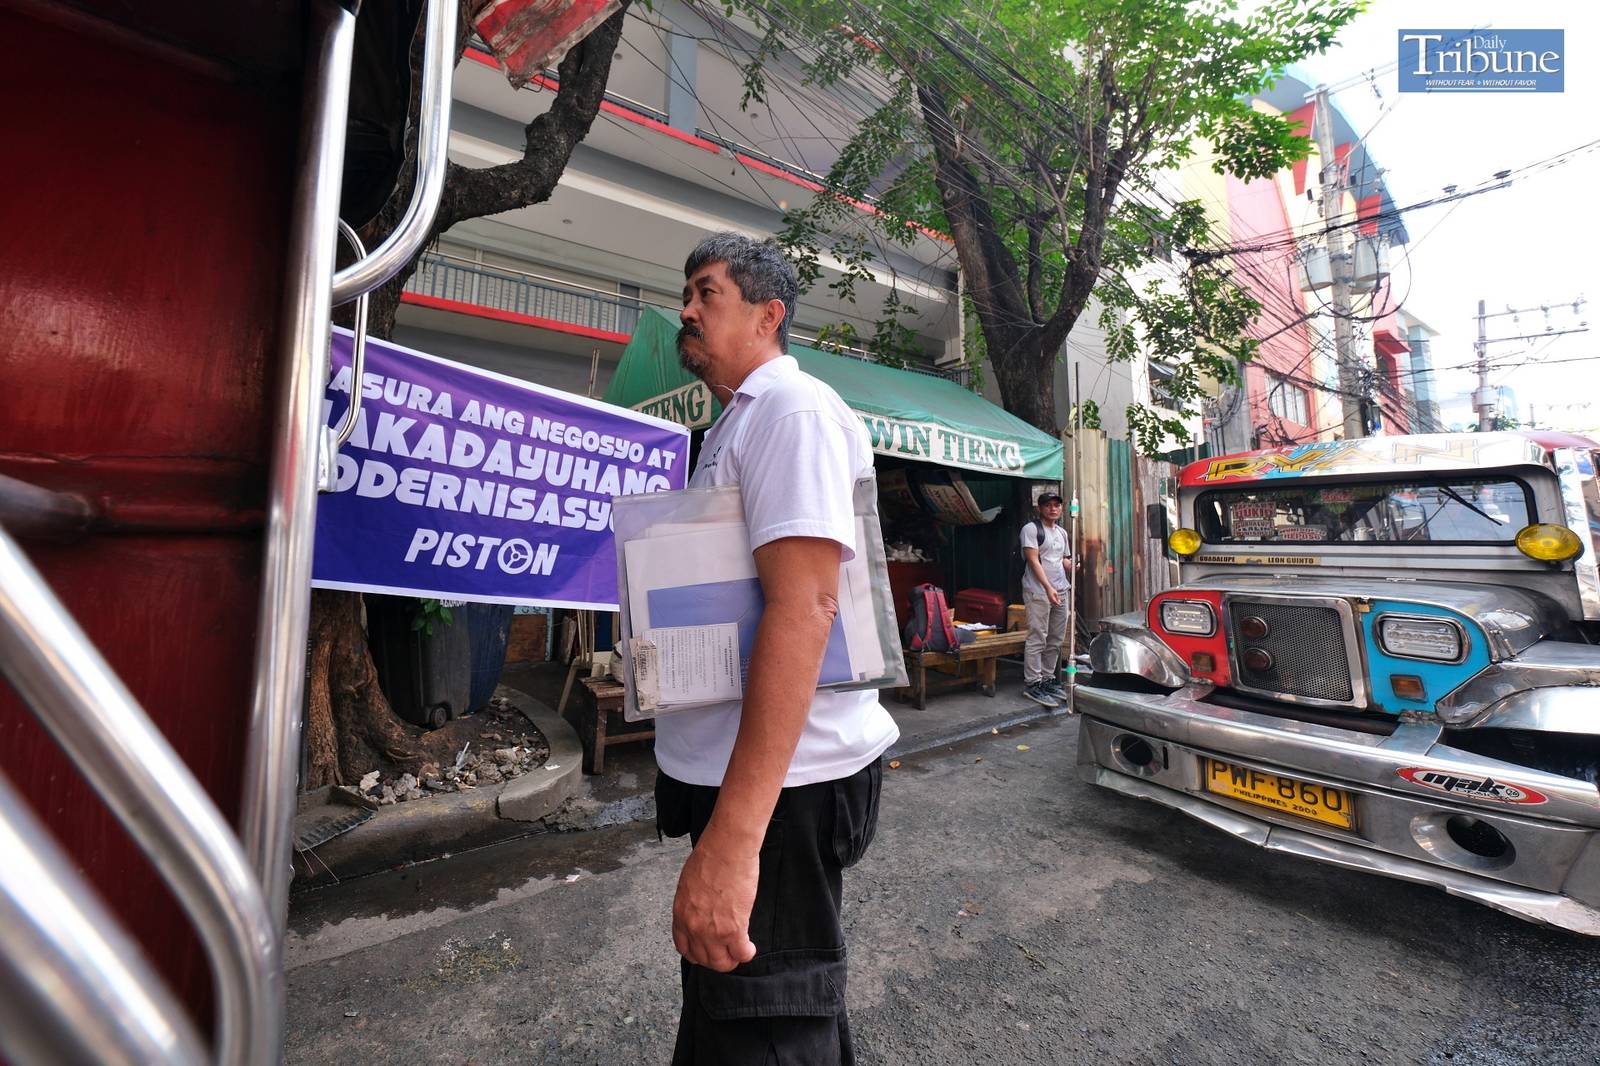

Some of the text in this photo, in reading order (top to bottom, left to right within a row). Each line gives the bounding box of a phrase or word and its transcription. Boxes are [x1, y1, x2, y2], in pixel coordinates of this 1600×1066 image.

[321, 399, 671, 497] AKADAYUHANG
[459, 399, 525, 436] ANG
[529, 416, 645, 463] NEGOSYO
[646, 447, 677, 471] AT
[938, 429, 1021, 470] TIENG
[404, 527, 560, 576] PISTON
[1233, 787, 1288, 809] PHILIPPINES
